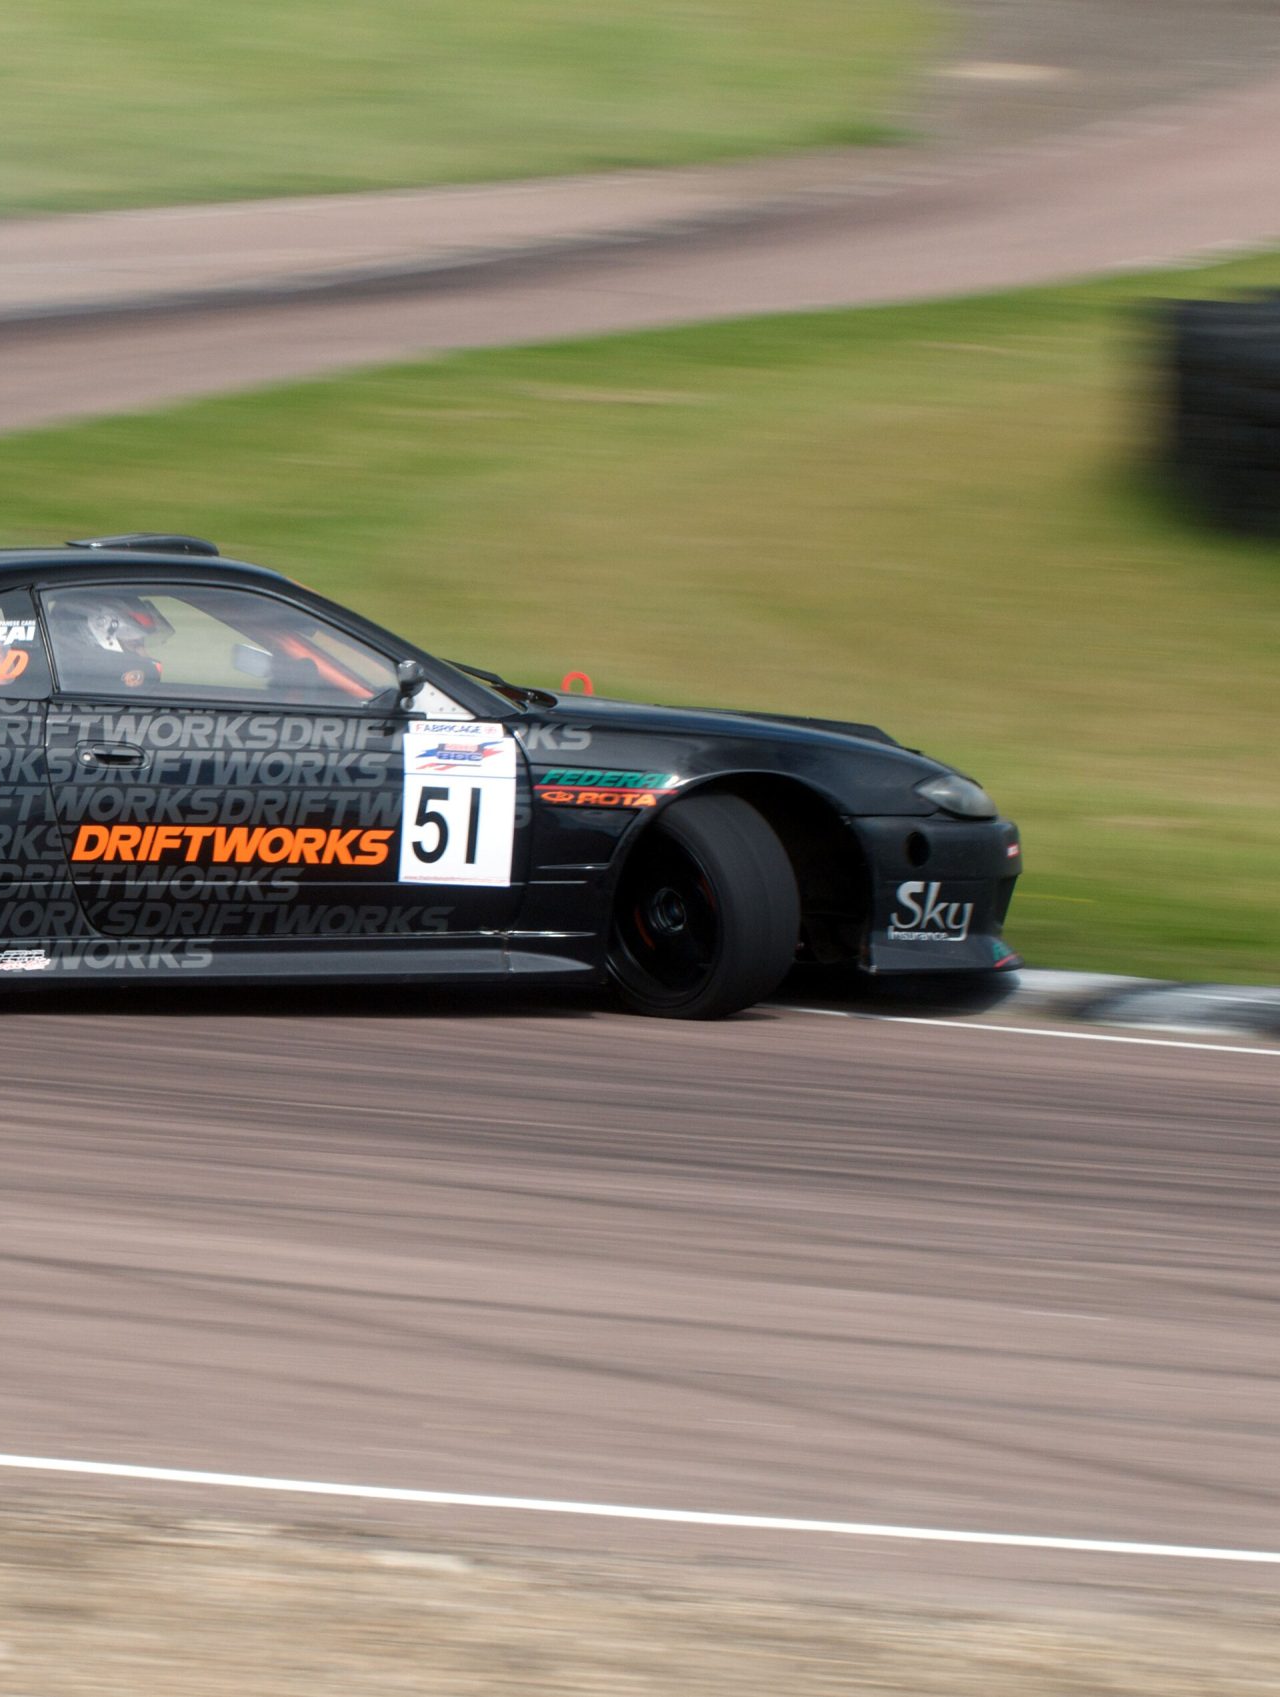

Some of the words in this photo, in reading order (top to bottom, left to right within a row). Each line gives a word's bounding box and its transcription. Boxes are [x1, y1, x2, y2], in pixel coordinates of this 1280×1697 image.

[411, 786, 483, 864] 51
[576, 792, 657, 808] ROTA
[71, 824, 395, 866] DRIFTWORKS
[889, 880, 975, 942] Sky
